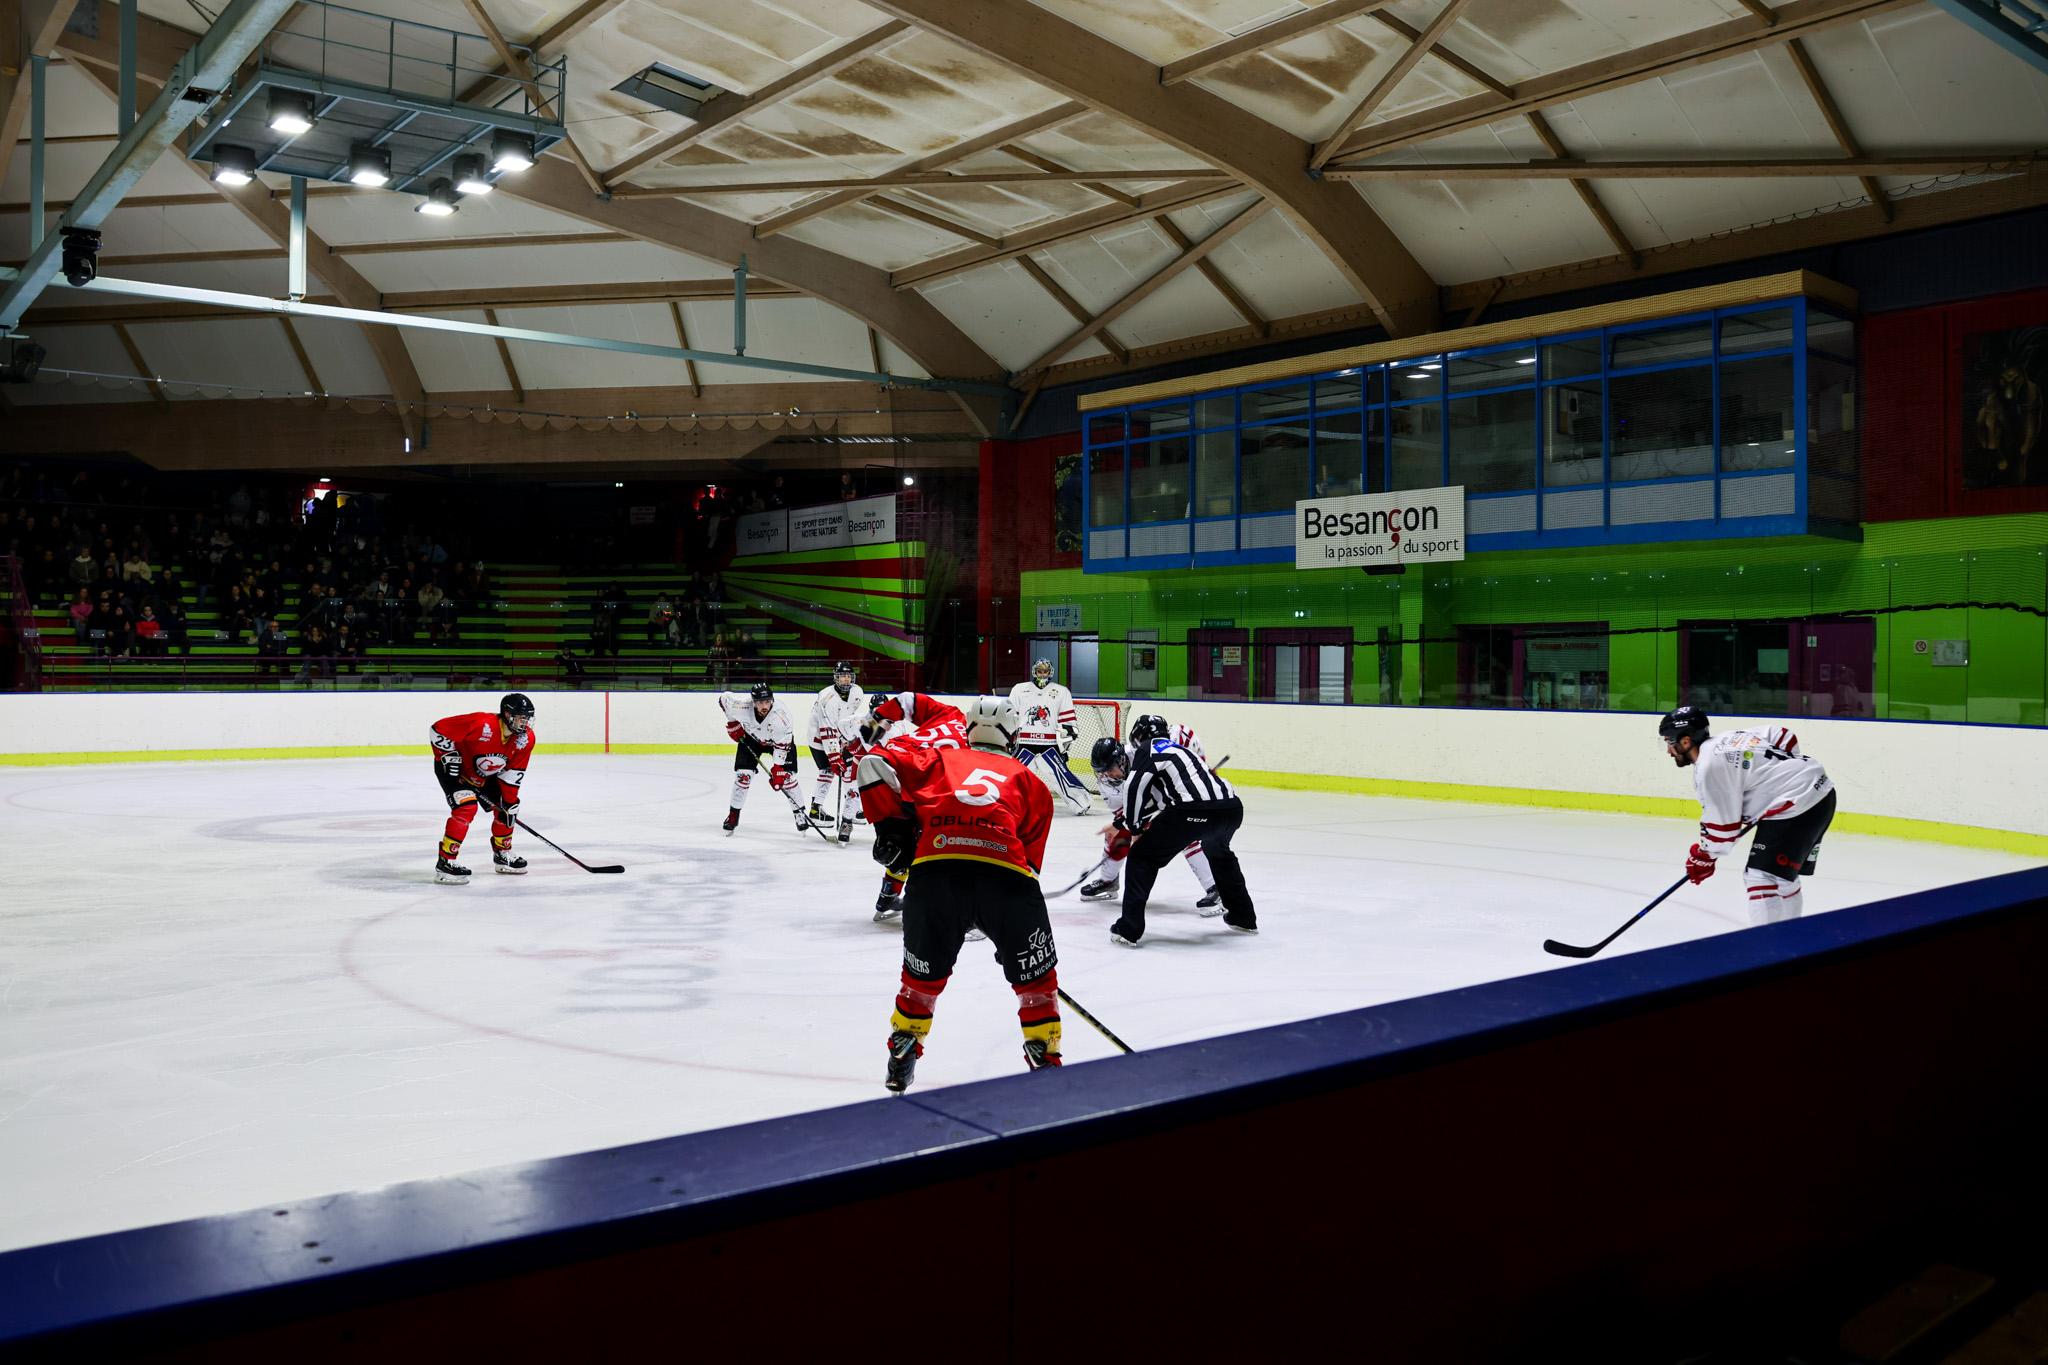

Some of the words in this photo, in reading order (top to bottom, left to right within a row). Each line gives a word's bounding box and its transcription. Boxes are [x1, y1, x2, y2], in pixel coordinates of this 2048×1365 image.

[801, 518, 818, 529] SPORT
[818, 517, 829, 527] EST
[829, 515, 843, 525] DANS
[848, 519, 886, 537] Besançon
[1304, 505, 1438, 550] Besançon
[747, 527, 779, 543] Besançon
[801, 528, 818, 538] NOTRE
[819, 525, 838, 537] NATURE
[1325, 544, 1335, 558] la
[1338, 543, 1383, 562] passion
[1403, 538, 1419, 554] du
[1422, 538, 1459, 556] sport
[434, 735, 452, 750] 23
[515, 772, 525, 785] 2
[954, 768, 1008, 807] 5
[1028, 927, 1047, 950] La
[1017, 939, 1055, 970] TABLE
[1020, 972, 1032, 981] DE
